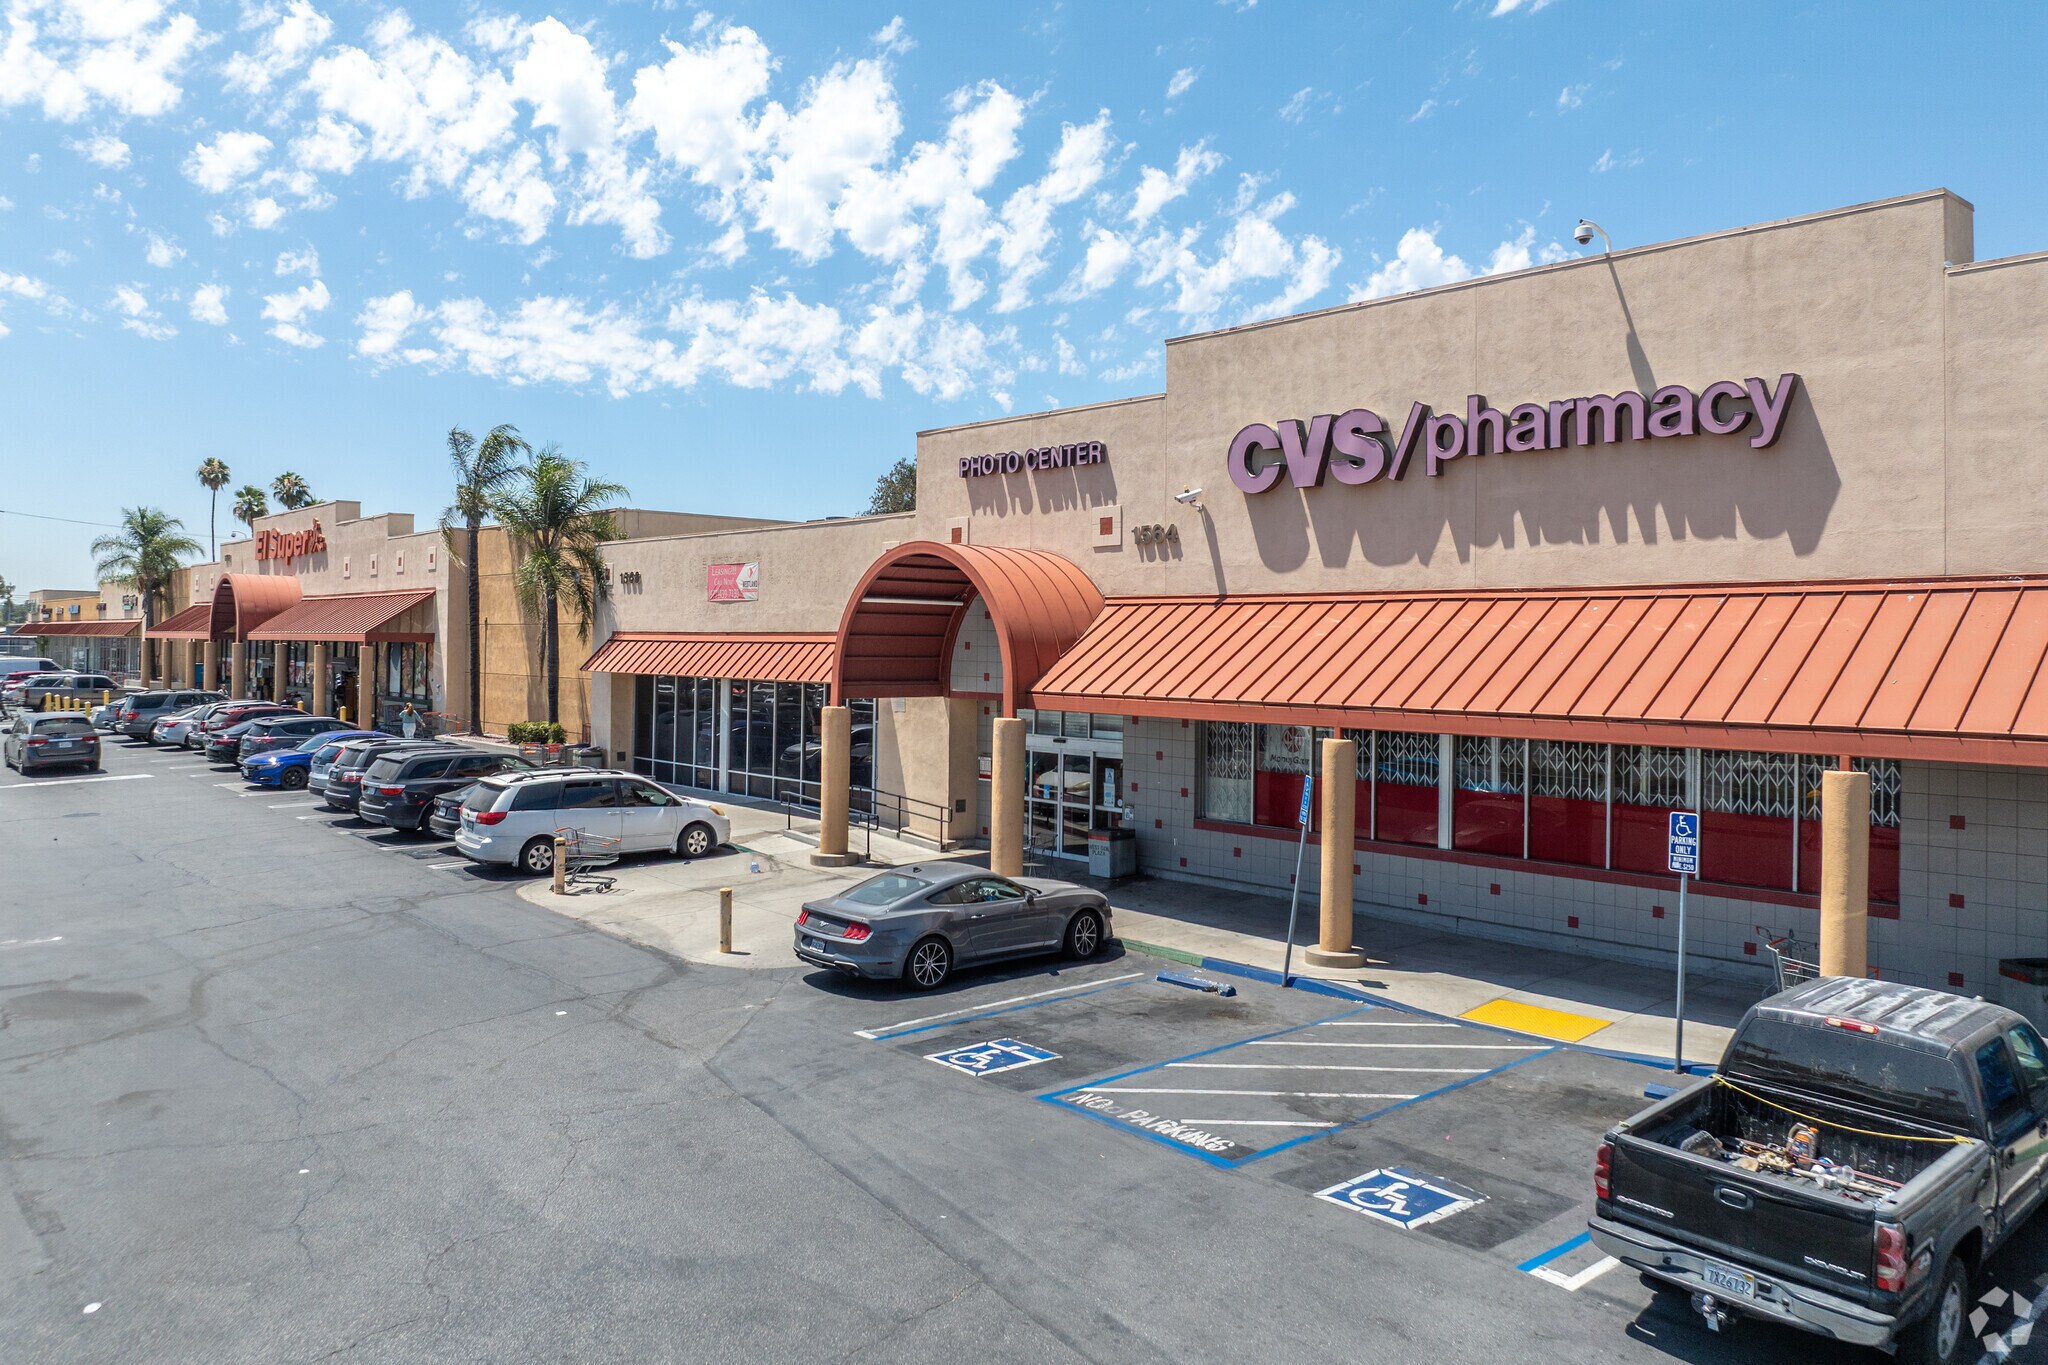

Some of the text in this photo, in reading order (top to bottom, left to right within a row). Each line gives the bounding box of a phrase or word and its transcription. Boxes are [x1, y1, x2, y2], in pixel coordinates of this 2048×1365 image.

[1228, 373, 1801, 494] CVS/pharmacy
[959, 441, 1105, 478] PHOTO CENTER
[255, 528, 309, 566] El Super
[1132, 523, 1179, 545] 1564
[1671, 836, 1696, 846] PARKING
[1675, 845, 1692, 854] ONLY
